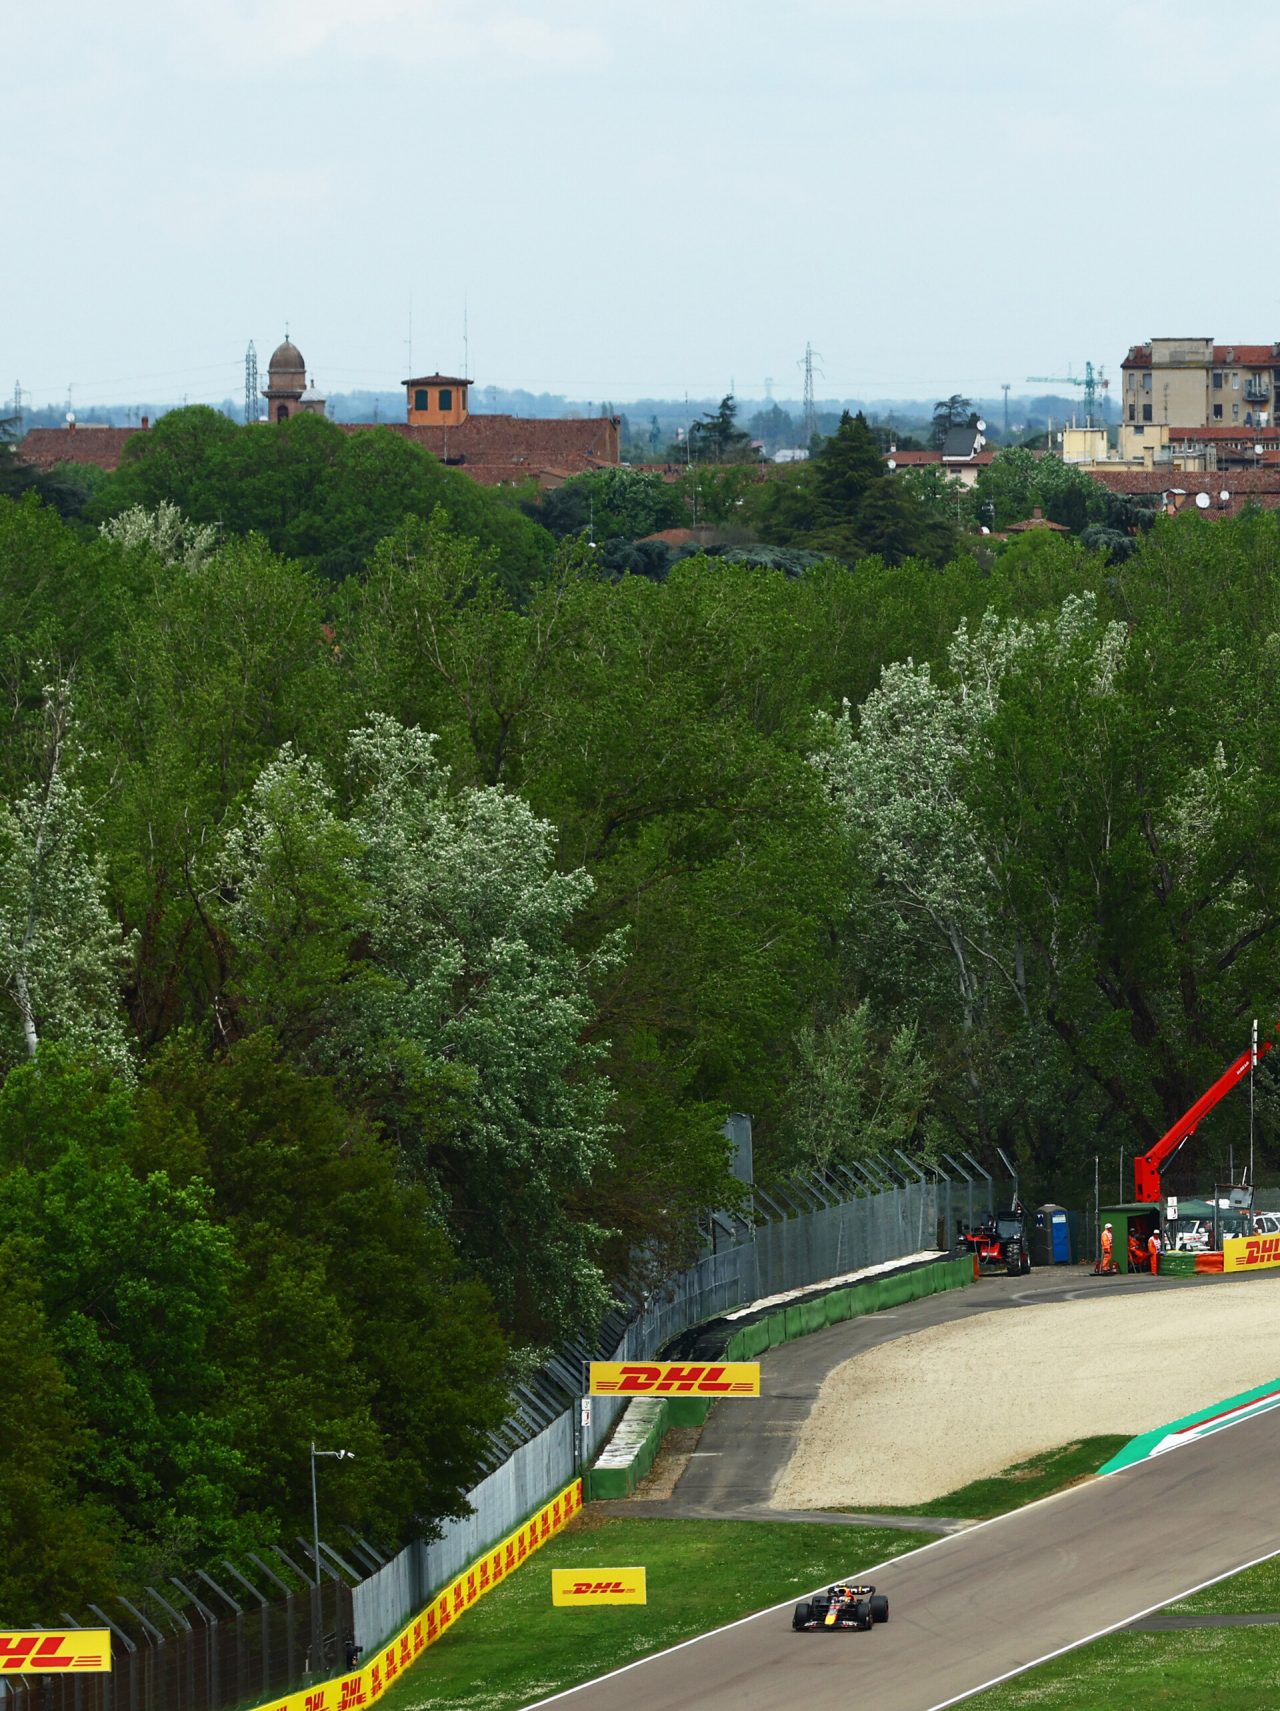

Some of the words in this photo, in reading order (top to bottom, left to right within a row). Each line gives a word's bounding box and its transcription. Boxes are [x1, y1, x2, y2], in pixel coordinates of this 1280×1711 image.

[618, 1367, 733, 1391] DHL
[572, 1582, 626, 1595] DHL
[0, 1637, 75, 1669] HL
